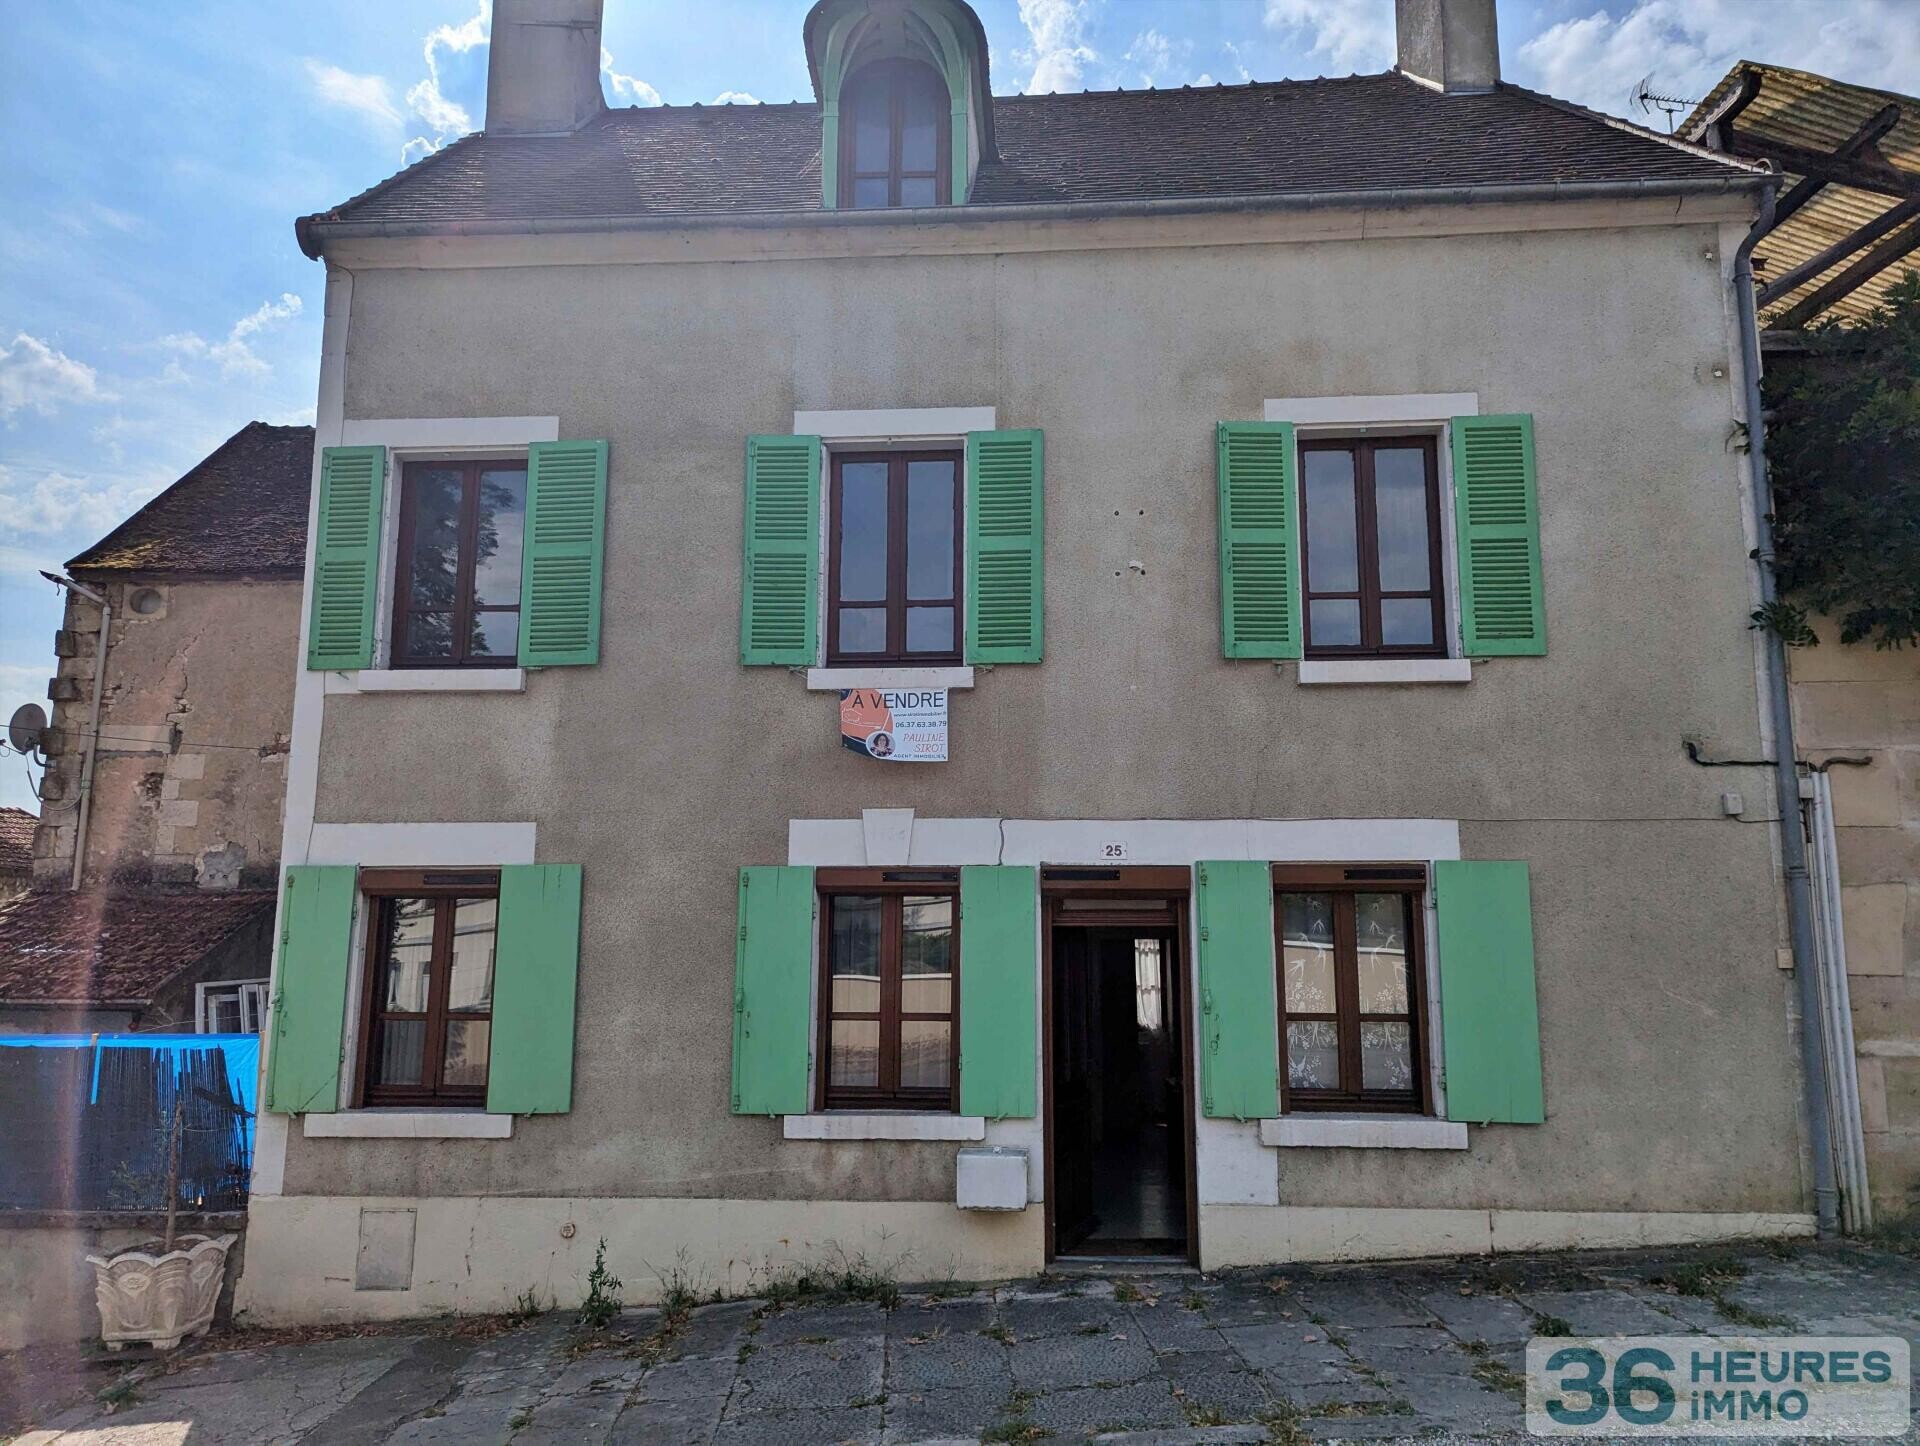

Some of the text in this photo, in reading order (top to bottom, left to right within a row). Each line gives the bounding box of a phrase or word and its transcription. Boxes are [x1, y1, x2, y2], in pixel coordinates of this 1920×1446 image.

[852, 691, 944, 708] À VENDRE
[895, 720, 947, 728] 06.37.63.38.79
[903, 732, 945, 742] PAULINE
[914, 743, 946, 752] SIROT
[1106, 845, 1122, 856] 25
